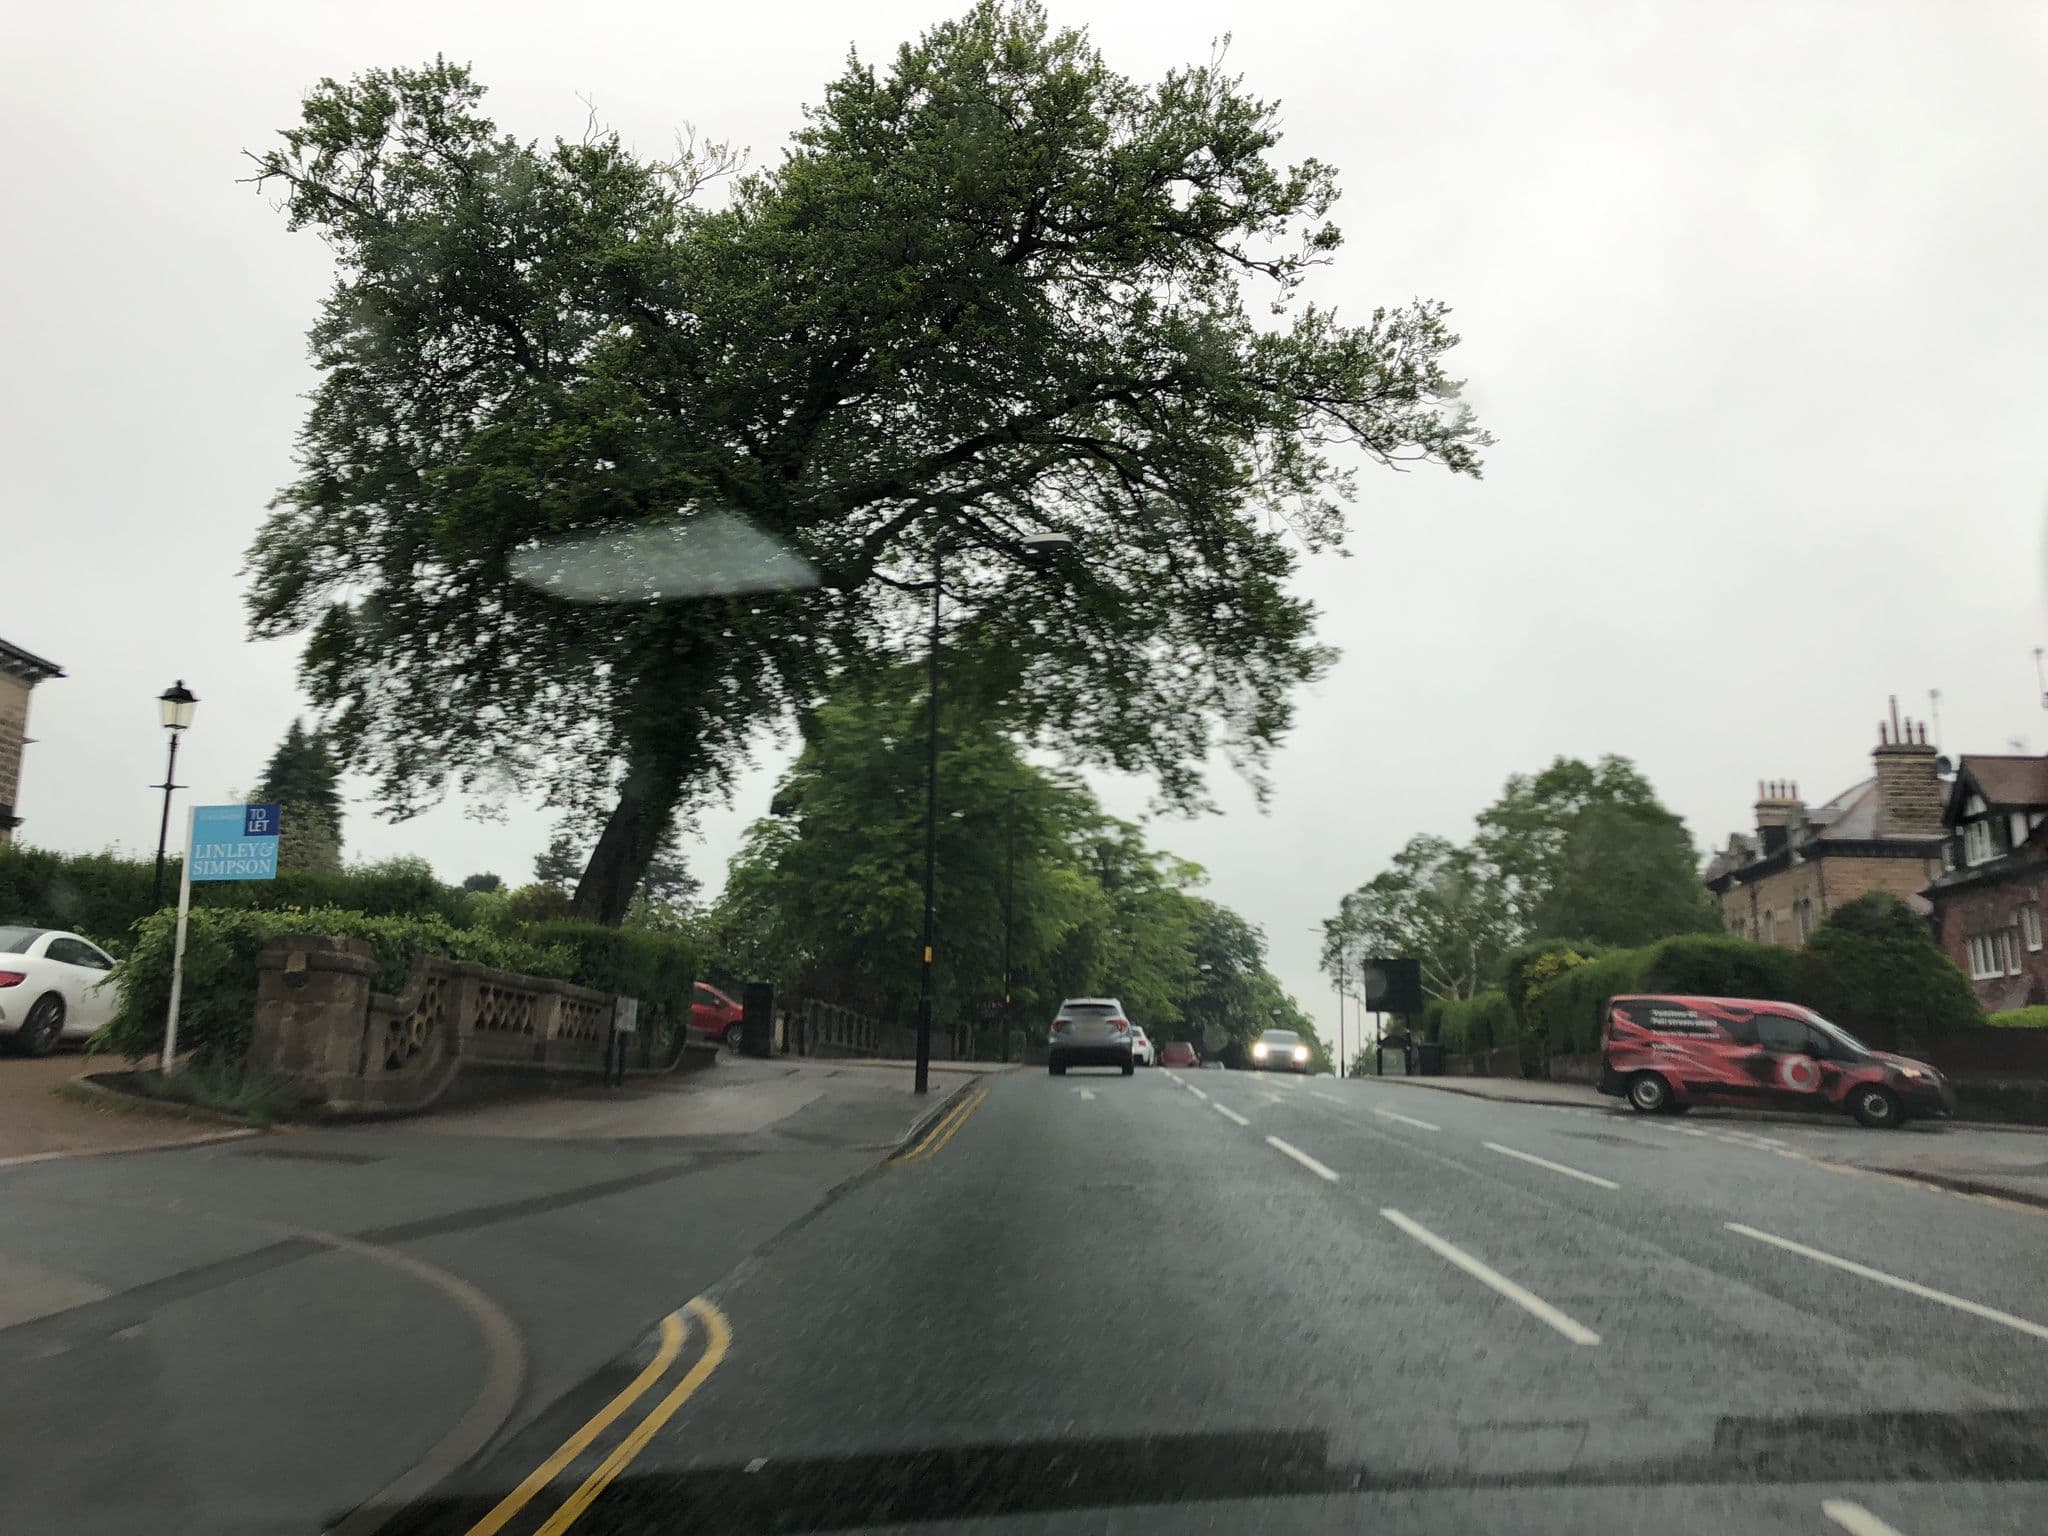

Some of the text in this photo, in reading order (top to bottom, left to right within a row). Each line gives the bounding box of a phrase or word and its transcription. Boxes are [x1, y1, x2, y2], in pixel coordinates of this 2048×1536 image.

[248, 808, 267, 820] TO
[247, 819, 270, 832] LET
[192, 859, 272, 875] SIMPSON
